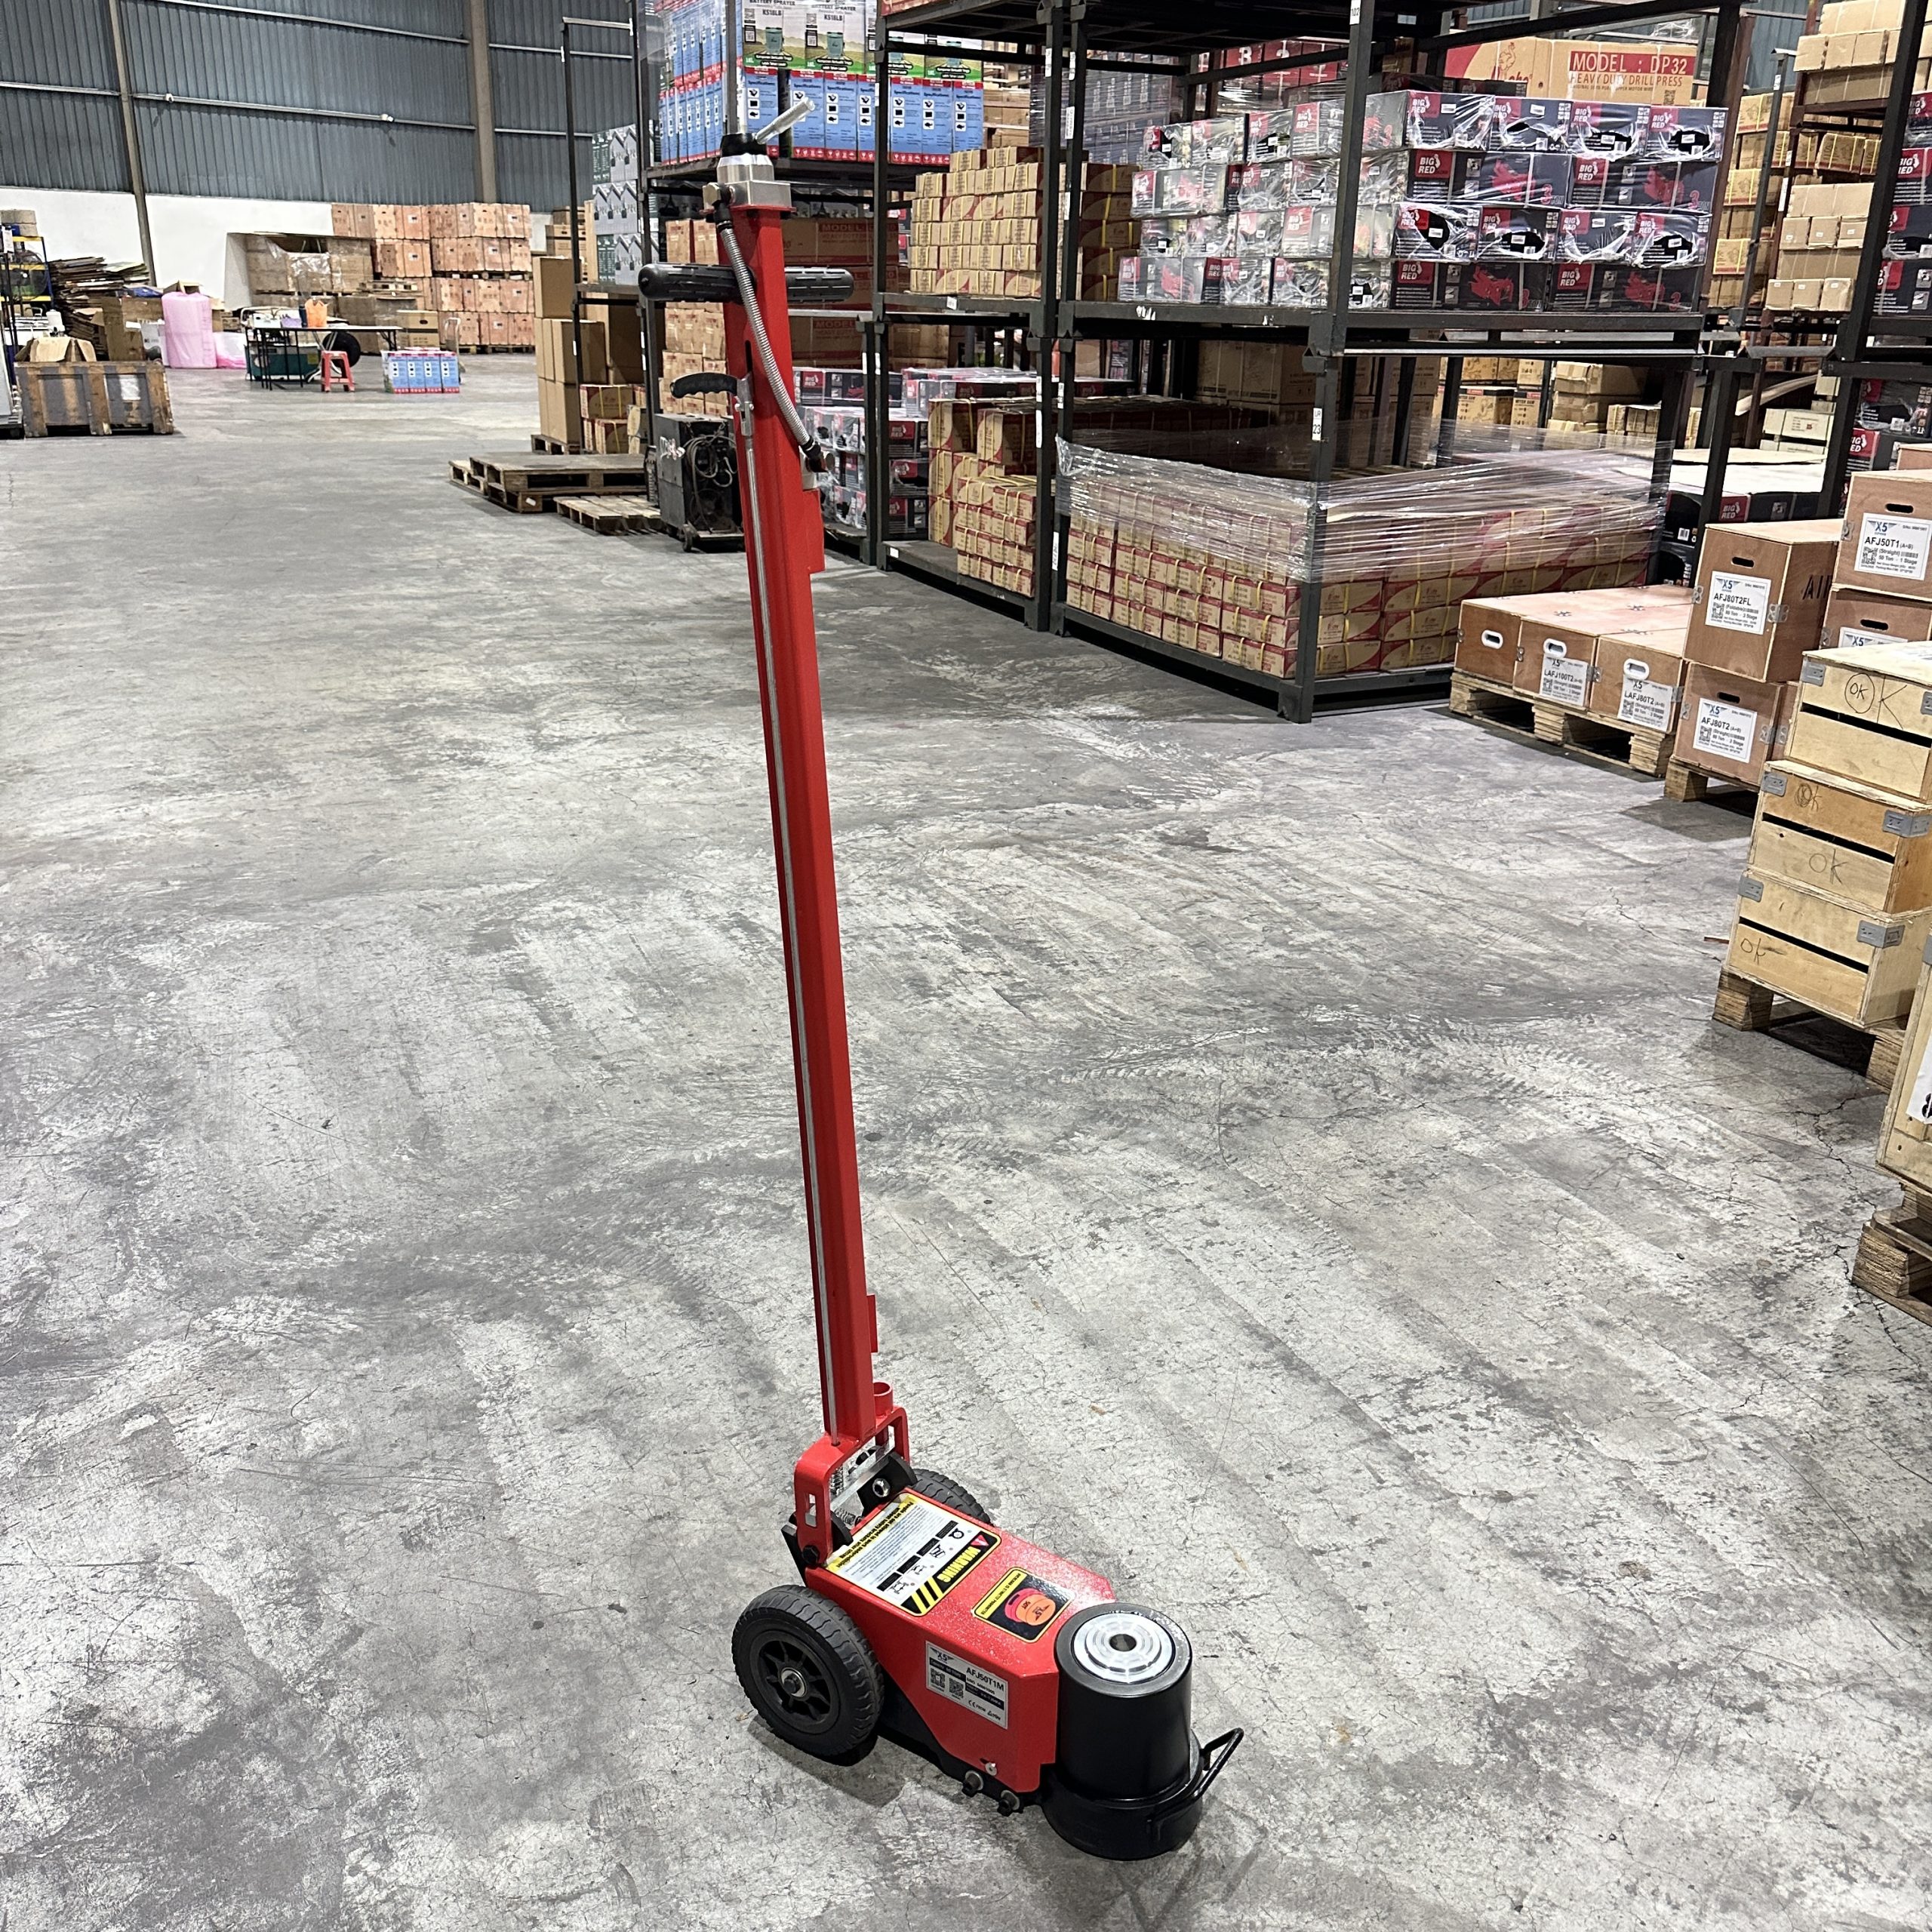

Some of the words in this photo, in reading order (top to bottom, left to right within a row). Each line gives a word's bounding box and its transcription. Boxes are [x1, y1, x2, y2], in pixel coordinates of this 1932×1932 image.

[1572, 53, 1627, 72] MODEL
[1650, 56, 1687, 75] DP32
[1571, 73, 1600, 85] HEAVY
[1629, 75, 1654, 85] DRILL
[1657, 76, 1683, 87] PRESS
[1420, 157, 1435, 165] BIG
[1418, 165, 1435, 174] RED
[1578, 172, 1593, 180] RED
[1402, 264, 1416, 272] BIG
[1313, 424, 1321, 434] 23
[1723, 504, 1736, 512] BIG
[1875, 521, 1887, 532] X5
[1865, 537, 1900, 548] AFJ50T1
[1722, 580, 1733, 589] X5
[1714, 593, 1751, 606] AFJ80T2FL
[1852, 637, 1863, 646] X5
[1552, 658, 1561, 667] X5
[1544, 669, 1574, 682] LAFJ100T2
[1633, 679, 1642, 689] X5
[1624, 691, 1654, 705] LAFJ80T2
[1709, 705, 1720, 715] X5
[1701, 717, 1730, 730] AFJ80T2
[937, 1546, 981, 1583] WARNING
[937, 1651, 948, 1661] X5
[966, 1667, 1004, 1691] AFJ50T1M
